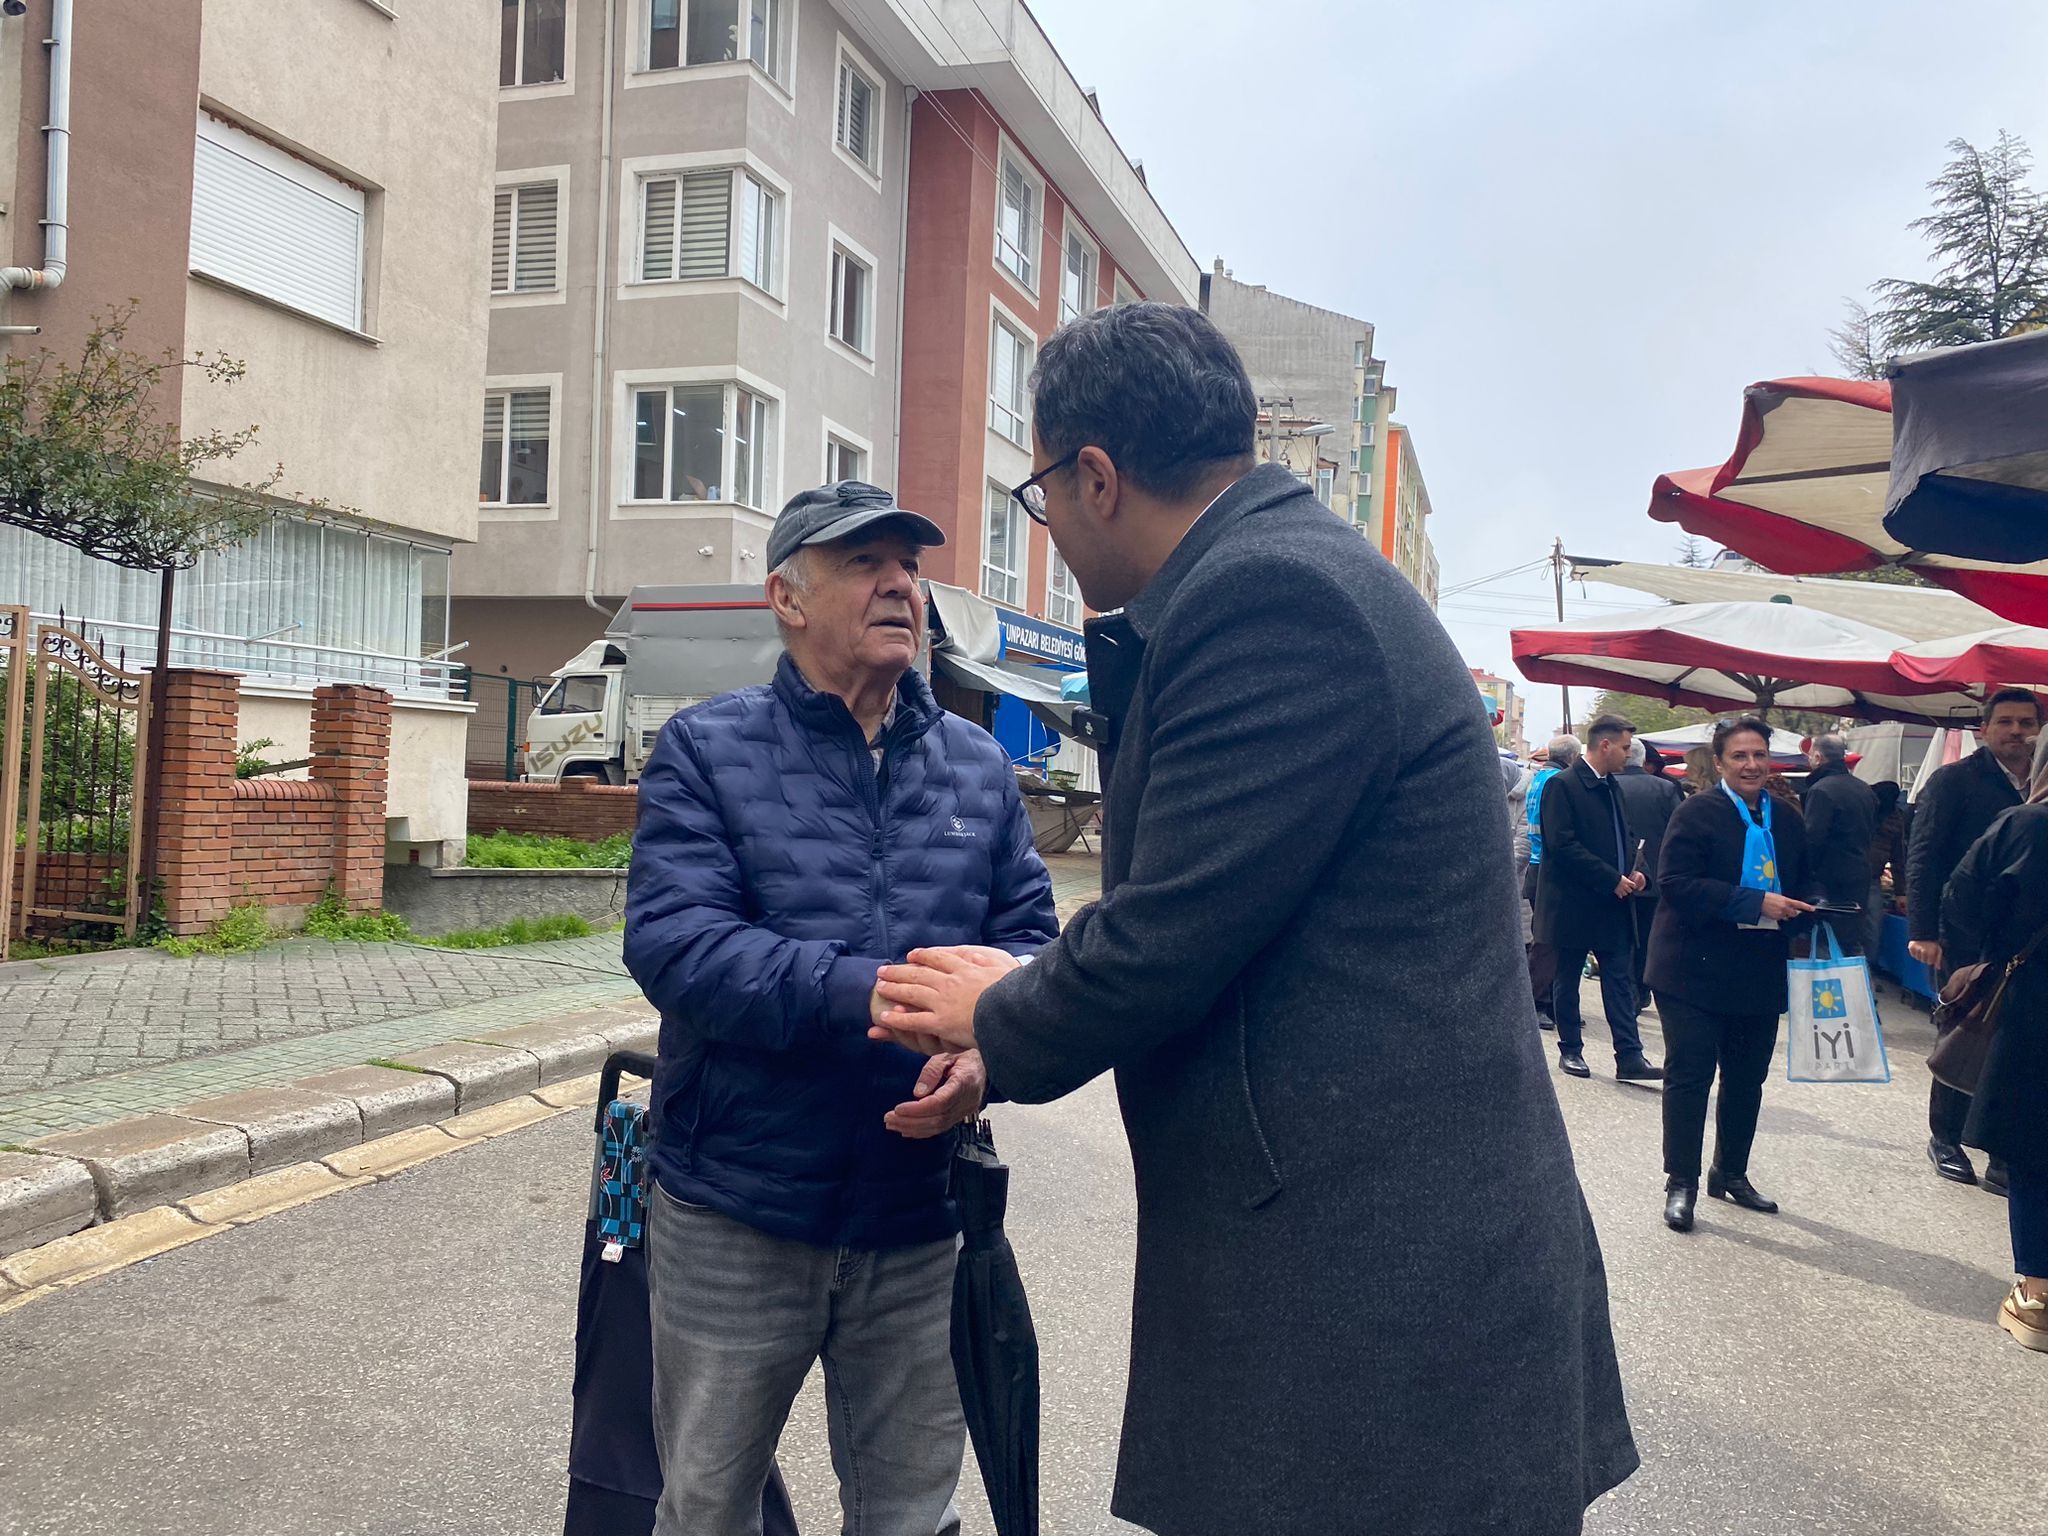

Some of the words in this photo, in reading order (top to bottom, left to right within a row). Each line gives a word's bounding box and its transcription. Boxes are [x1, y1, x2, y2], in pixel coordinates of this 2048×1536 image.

[998, 621, 1039, 649] UNPAZARI
[1041, 634, 1074, 659] BELEDİYESİ
[529, 713, 603, 773] ISUZU
